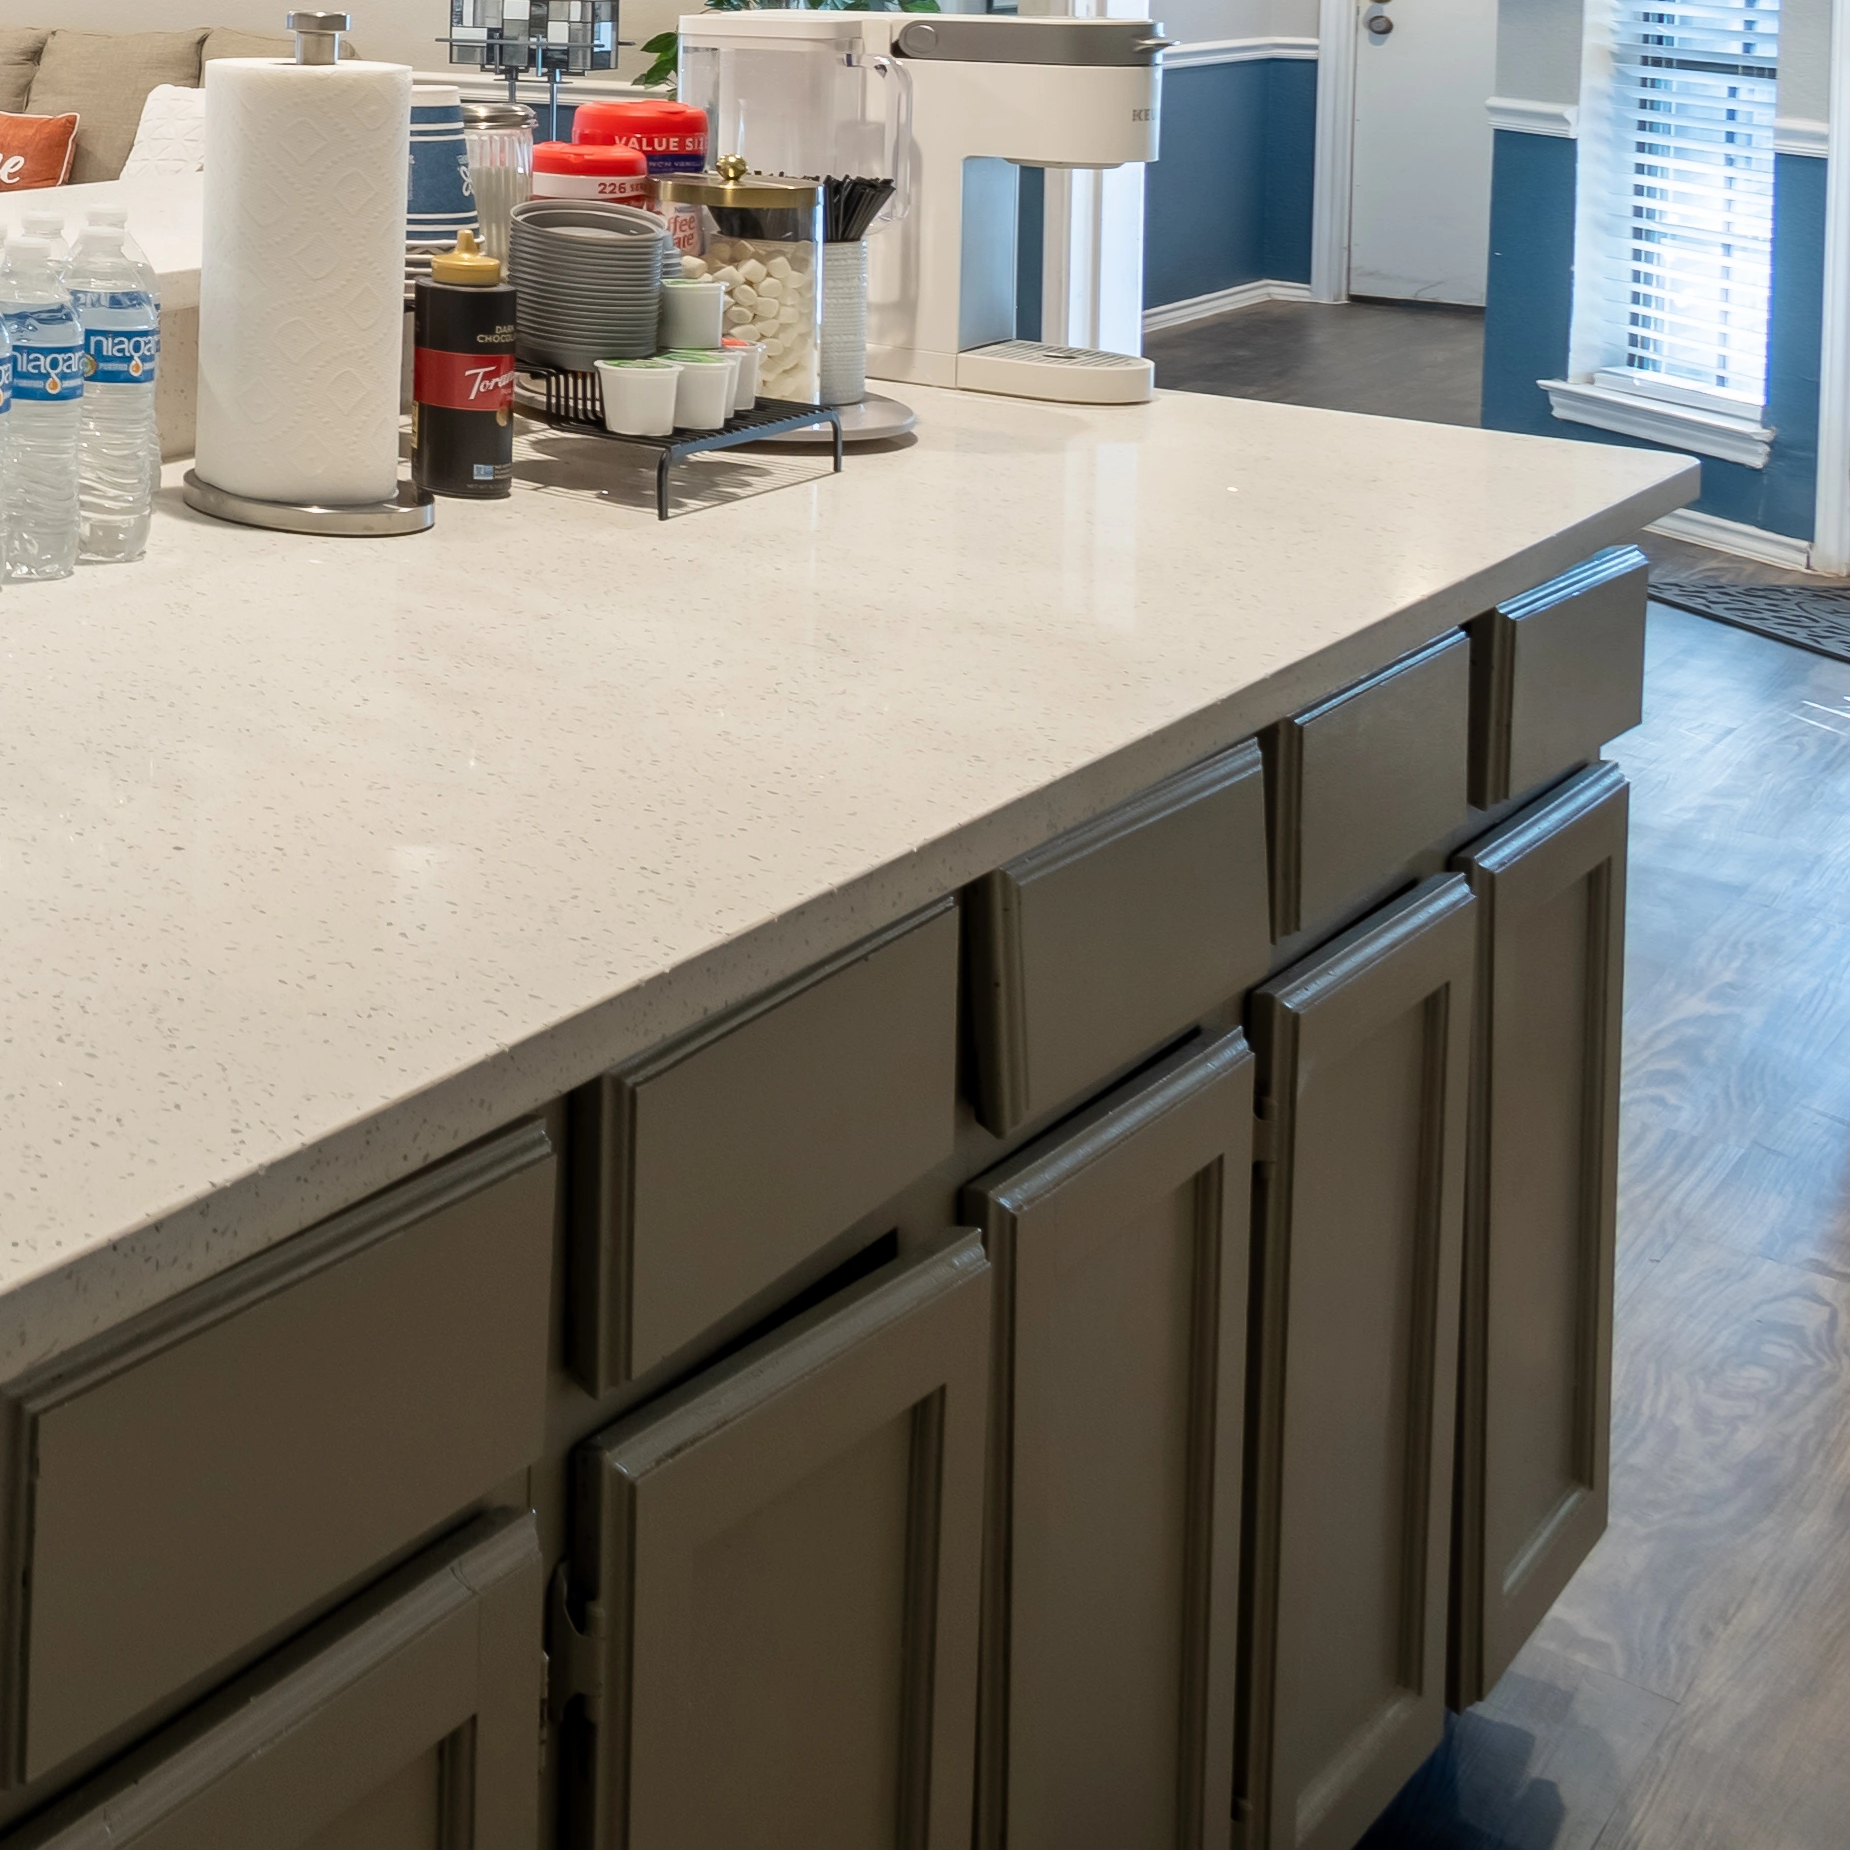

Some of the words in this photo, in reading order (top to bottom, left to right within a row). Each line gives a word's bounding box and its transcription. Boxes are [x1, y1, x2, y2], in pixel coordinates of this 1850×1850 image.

[615, 135, 679, 151] VALUE
[598, 183, 626, 194] 226
[668, 215, 696, 236] ffee
[496, 325, 515, 334] DAR
[90, 334, 156, 367] niaga
